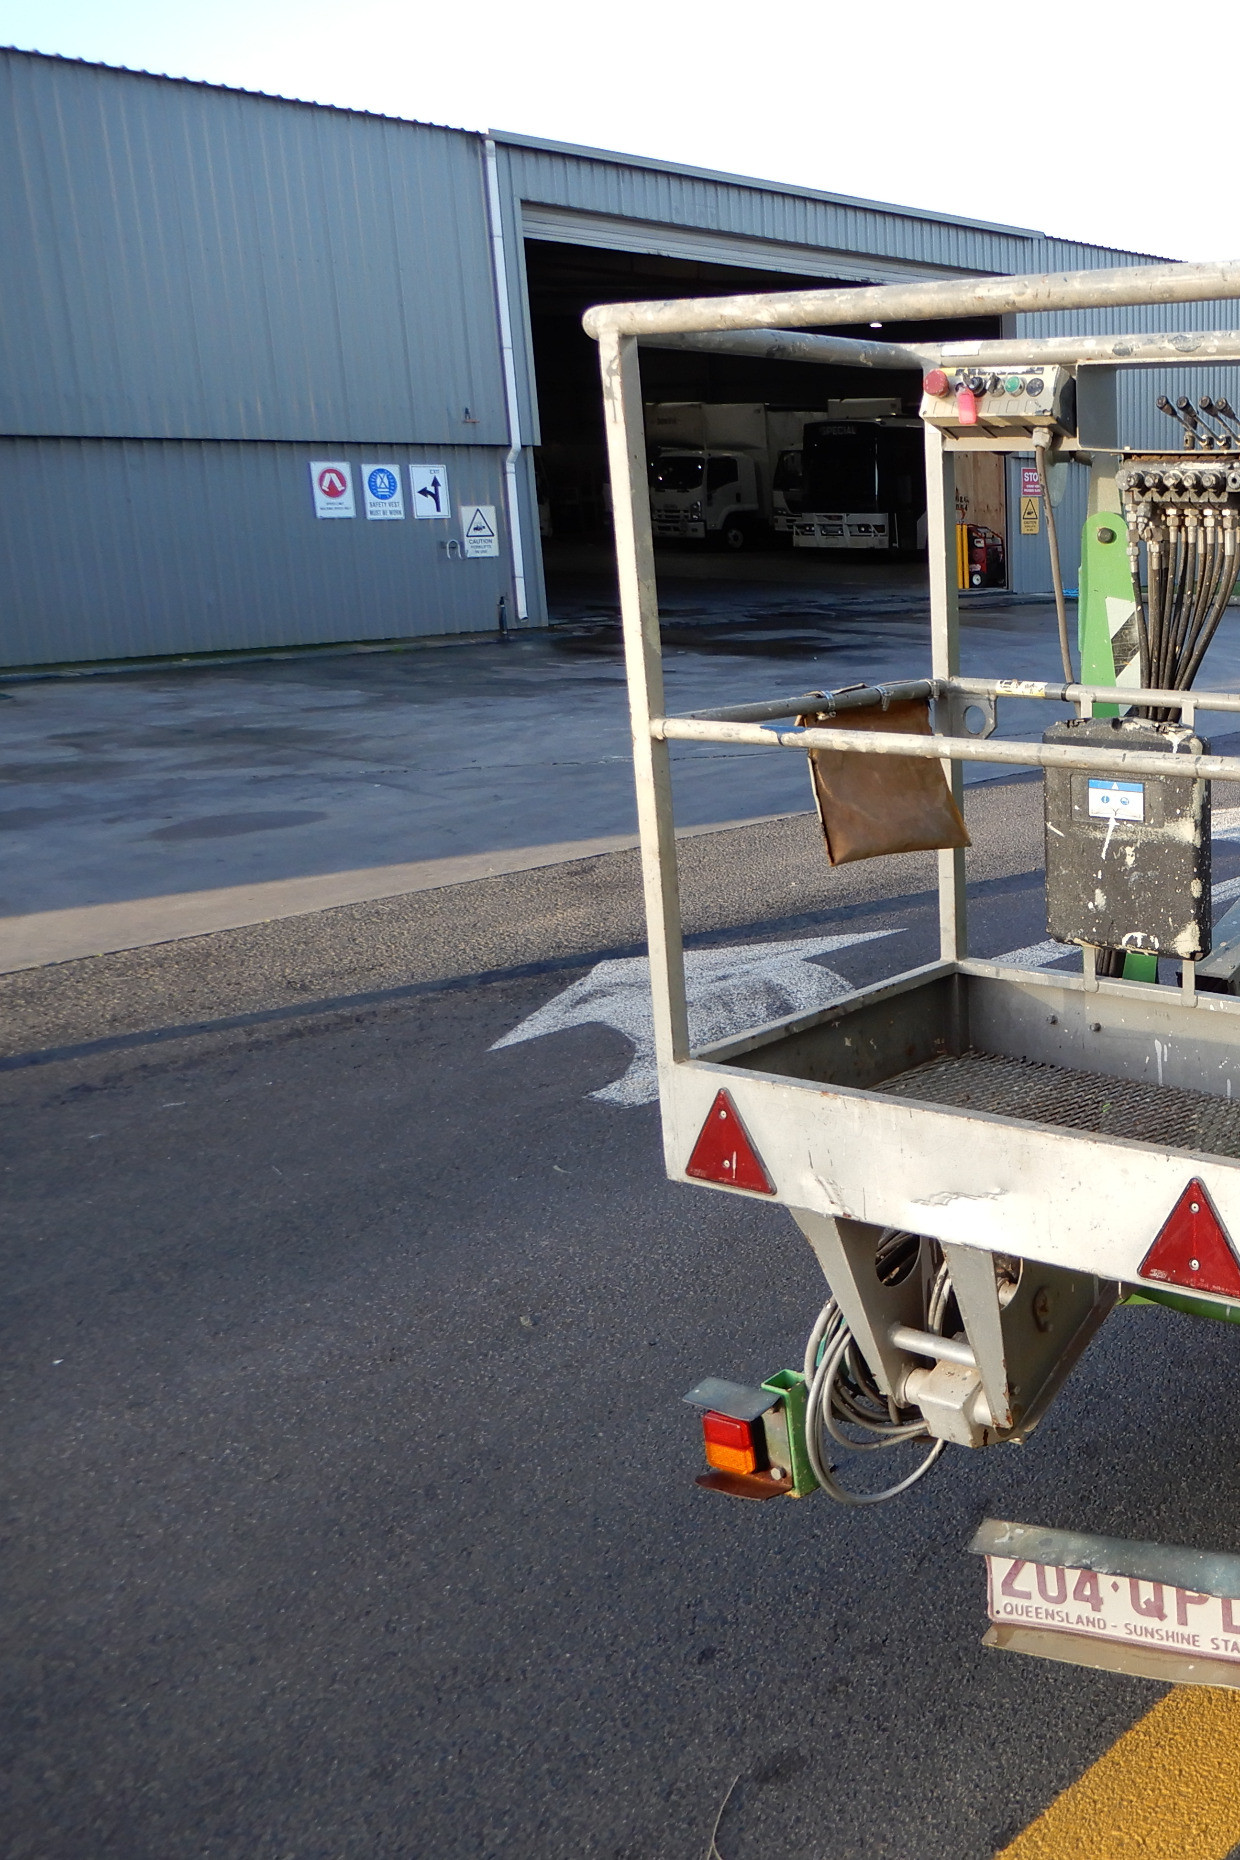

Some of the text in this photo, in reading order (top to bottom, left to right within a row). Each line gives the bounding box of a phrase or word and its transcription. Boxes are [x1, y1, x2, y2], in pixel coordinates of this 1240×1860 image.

[1023, 472, 1039, 482] STO
[1003, 1602, 1107, 1630] QUEENSLAND
[1124, 1622, 1201, 1648] SUNSHINE
